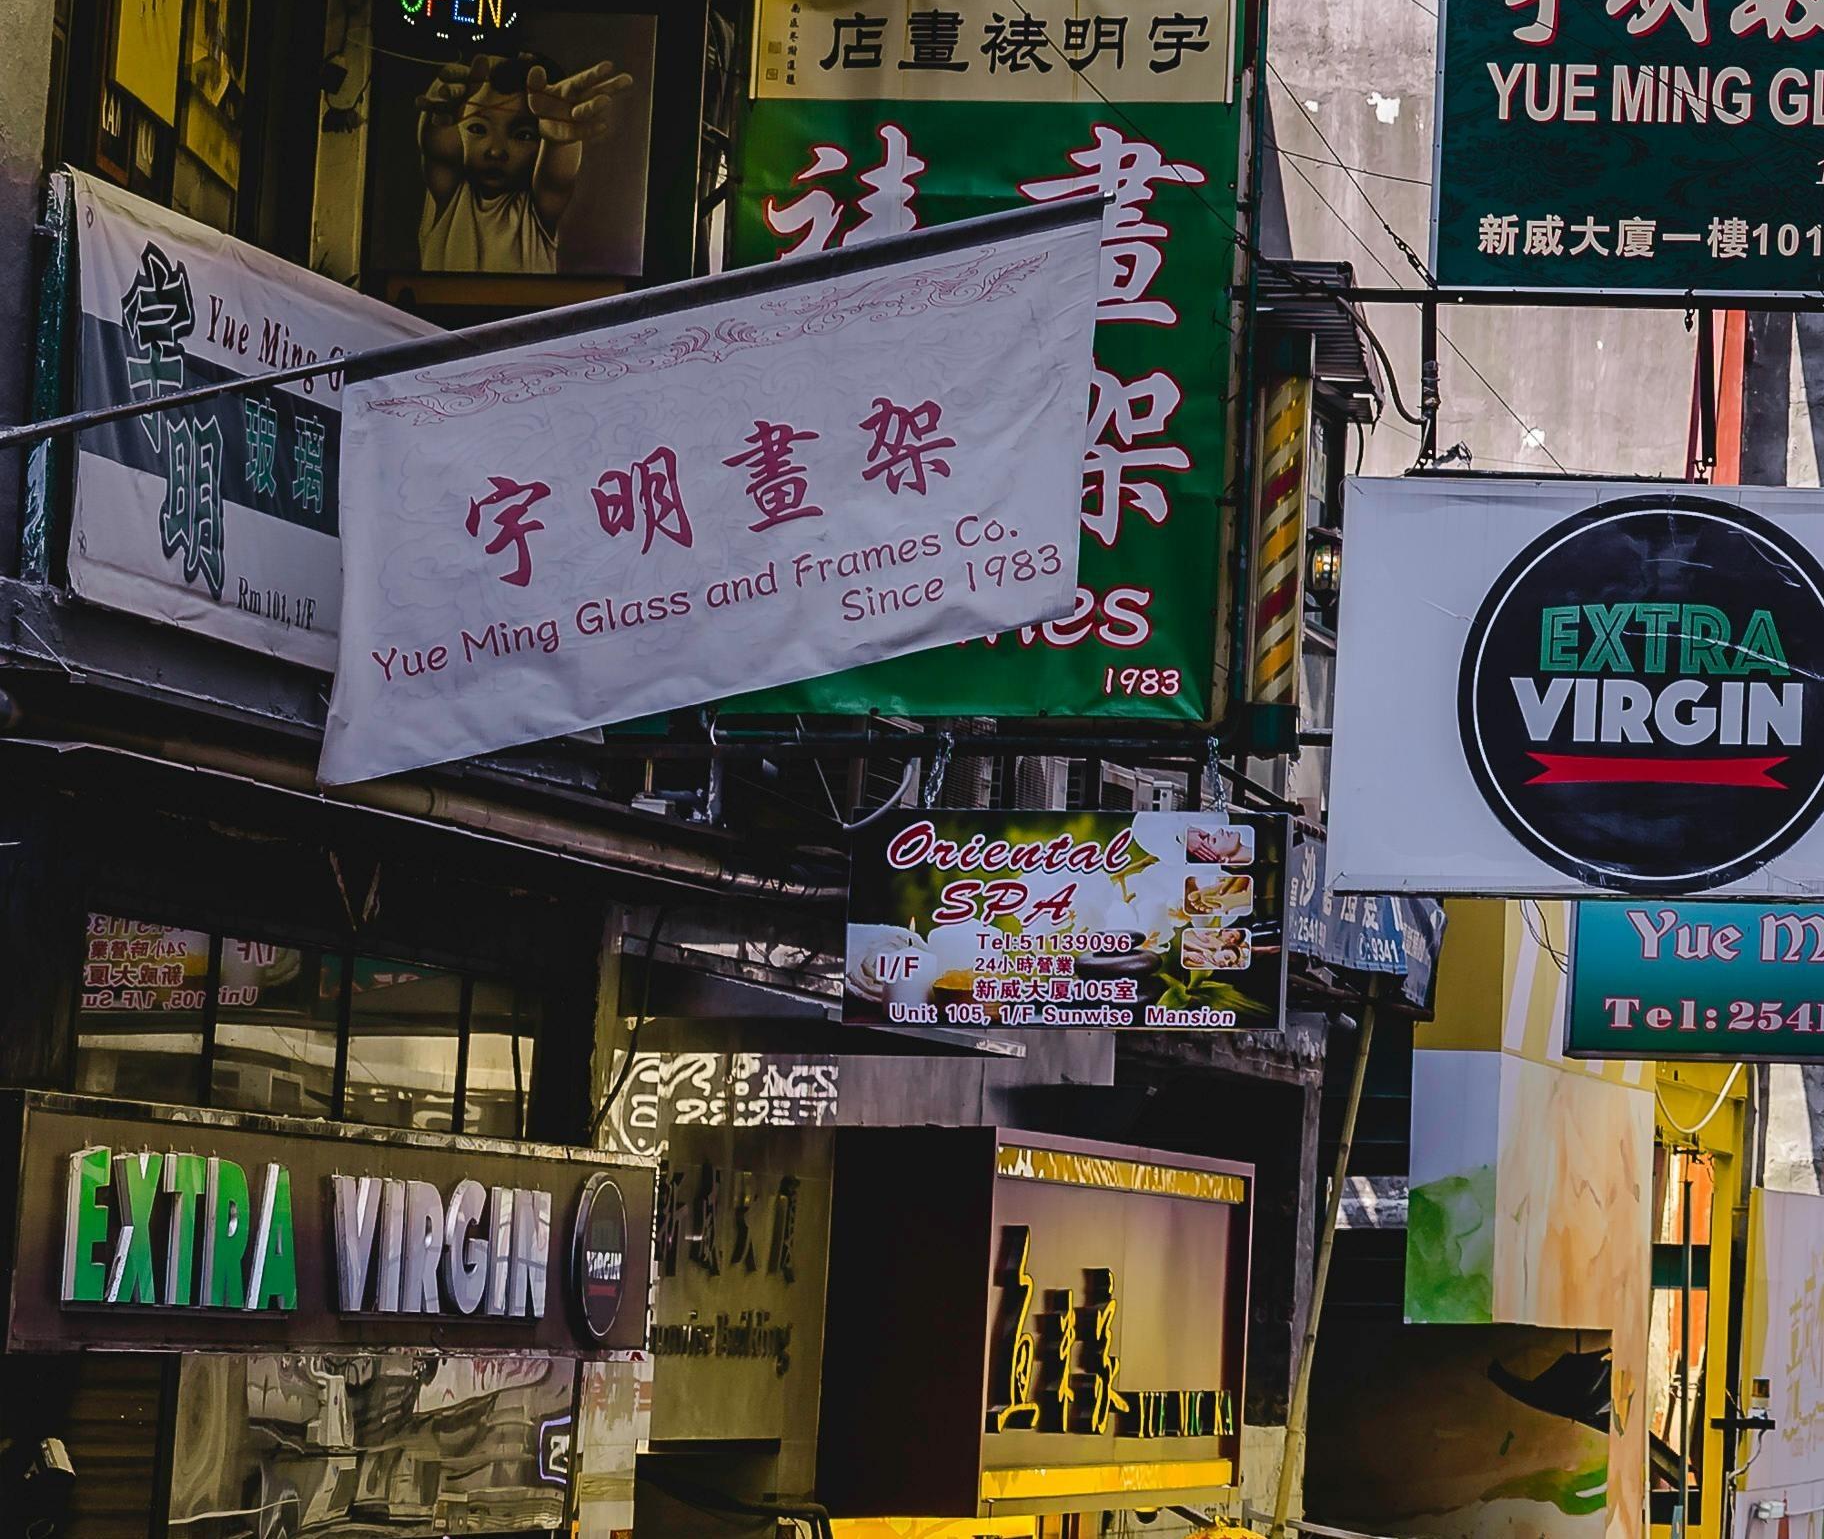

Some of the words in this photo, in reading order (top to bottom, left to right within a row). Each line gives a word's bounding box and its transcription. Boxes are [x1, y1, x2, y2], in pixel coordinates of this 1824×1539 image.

[1486, 63, 1597, 124] YUE
[1612, 64, 1752, 128] MING
[209, 294, 248, 343] Yue
[464, 396, 956, 588] 宇明畫架
[237, 577, 261, 615] Rm
[372, 646, 448, 683] Yue
[462, 616, 560, 663] Ming
[576, 591, 691, 636] Glass
[707, 562, 778, 609] and
[792, 532, 941, 590] Frames
[954, 514, 1018, 548] Co.
[840, 577, 946, 623] Since
[963, 544, 1062, 594] 1983
[1539, 603, 1791, 677] EXTRA
[1103, 667, 1181, 696] 1983
[1511, 678, 1802, 746] VIRGIN
[887, 821, 1133, 871] Oriental
[932, 880, 1078, 926] SPA
[976, 933, 1131, 951] Tel:51139096
[1626, 910, 1740, 963] Yue
[974, 957, 1074, 975] 24小時營業
[890, 1003, 937, 1022] Unit
[947, 1003, 990, 1027] 105,
[1001, 1005, 1033, 1025] 1/F
[1043, 1006, 1132, 1026] Sunwise
[1145, 1007, 1235, 1027] Mansion
[61, 1145, 298, 1310] EXTRA
[332, 1173, 553, 1319] VIRGIN
[586, 1250, 621, 1280] VIRGIN
